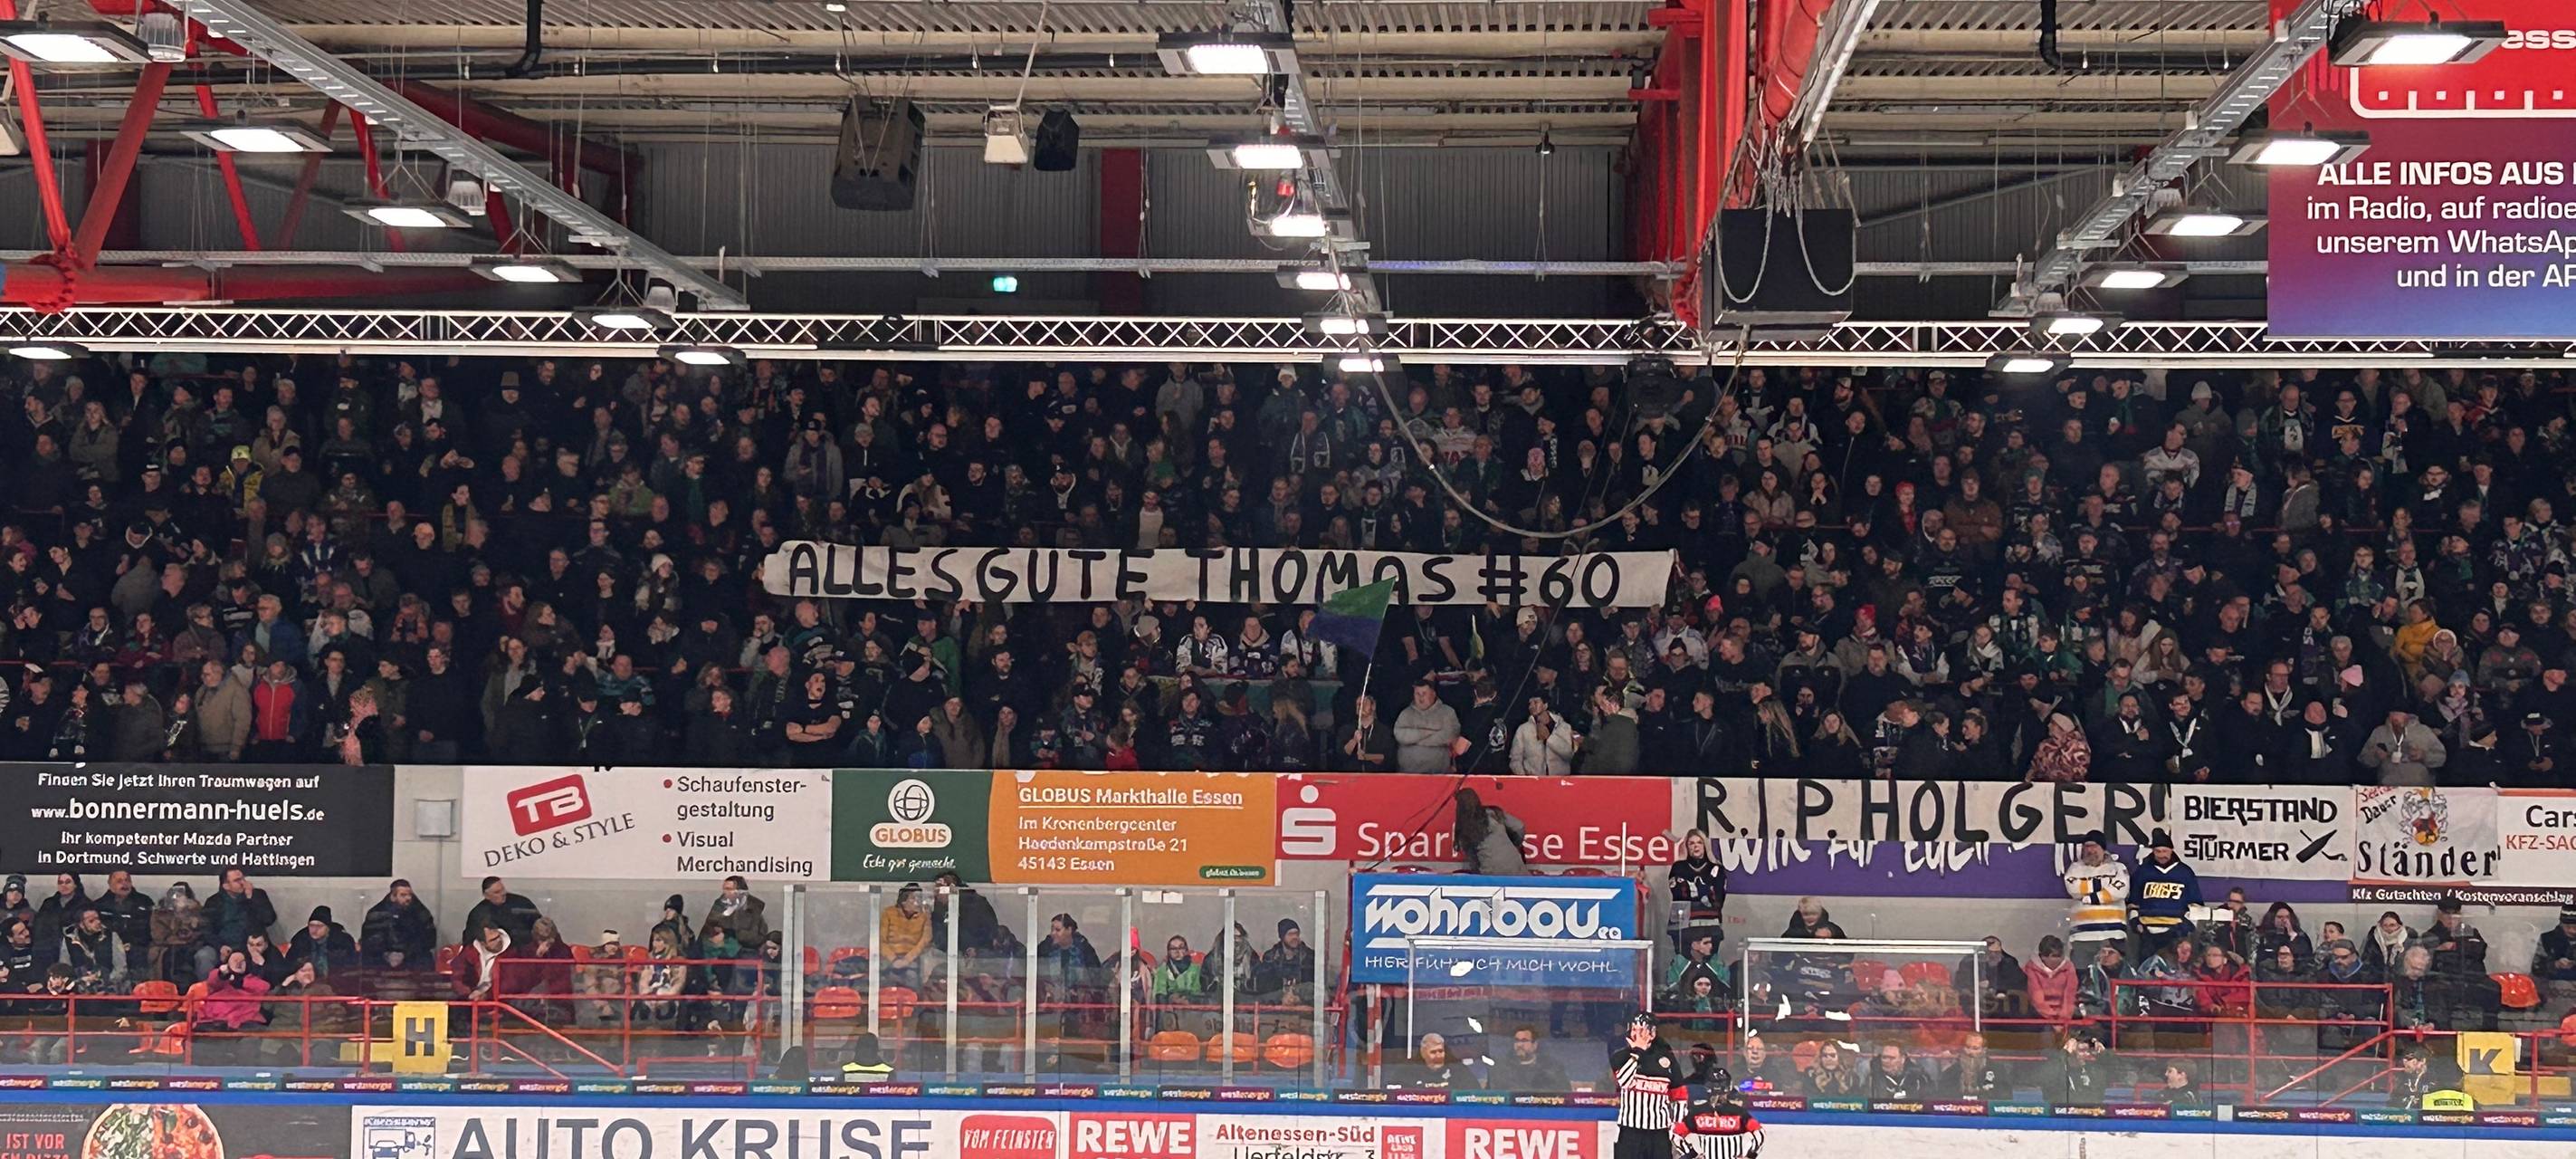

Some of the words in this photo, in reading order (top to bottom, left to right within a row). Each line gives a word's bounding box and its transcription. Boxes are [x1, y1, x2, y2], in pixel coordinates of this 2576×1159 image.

[2317, 162, 2391, 186] ALLE
[2400, 162, 2493, 186] INFOS
[2499, 161, 2564, 186] AUS
[2307, 196, 2339, 219] im
[2349, 196, 2432, 223] Radio,
[2440, 196, 2485, 219] auf
[2317, 235, 2439, 254] unserem
[2398, 263, 2447, 287] und
[2456, 263, 2478, 287] in
[2488, 263, 2535, 287] der
[790, 543, 963, 601] ALLES
[977, 549, 1154, 602] GUTE
[1186, 549, 1455, 605] THOMAS
[1478, 552, 1619, 608] #60
[38, 773, 87, 788] Finden
[91, 773, 115, 788] Sie
[117, 773, 154, 790] jetzt
[157, 773, 196, 788] Ihren
[199, 774, 291, 790] Traumwagen
[295, 774, 320, 788] auf
[677, 776, 806, 793] Schaufenster-
[515, 784, 585, 823] TB
[1018, 788, 1091, 804] GLOBUS
[1095, 788, 1188, 804] Markthalle
[1192, 790, 1243, 806] Essen
[31, 798, 325, 821] www.bonnermann-huels.de
[677, 801, 775, 821] gestaltung
[2184, 795, 2337, 826] BIERSTAND
[2526, 805, 2576, 828] Car
[1018, 817, 1038, 830] Im
[62, 831, 81, 846] Ihr
[85, 831, 178, 848] kompetenter
[183, 831, 232, 846] Mazda
[236, 832, 293, 847] Partner
[484, 836, 545, 867] DEKO
[552, 831, 570, 848] &
[573, 812, 635, 845] STYLE
[677, 832, 733, 848] Visual
[875, 827, 947, 844] GLOBUS
[1169, 838, 1188, 852] 21
[1358, 822, 1563, 860] Sparse
[138, 851, 206, 866] Schwerte
[210, 852, 238, 866] und
[242, 852, 315, 868] Hattingen
[677, 856, 813, 876] Merchandising
[1017, 857, 1066, 870] 45143
[1070, 857, 1115, 871] Essen
[2376, 888, 2441, 900] Gutachten
[1365, 956, 1408, 969] HIER
[1416, 955, 1461, 969] FÜH
[1506, 958, 1552, 972] MICH
[405, 1018, 434, 1056] H
[2469, 1049, 2504, 1075] K
[6, 1134, 29, 1149] IST
[34, 1134, 64, 1149] VOR
[452, 1118, 653, 1159] AUTO
[682, 1119, 931, 1159] KRUSE
[1076, 1120, 1191, 1154] REWE
[1216, 1124, 1375, 1145] Altenessen-Süd
[1465, 1128, 1579, 1159] REWE
